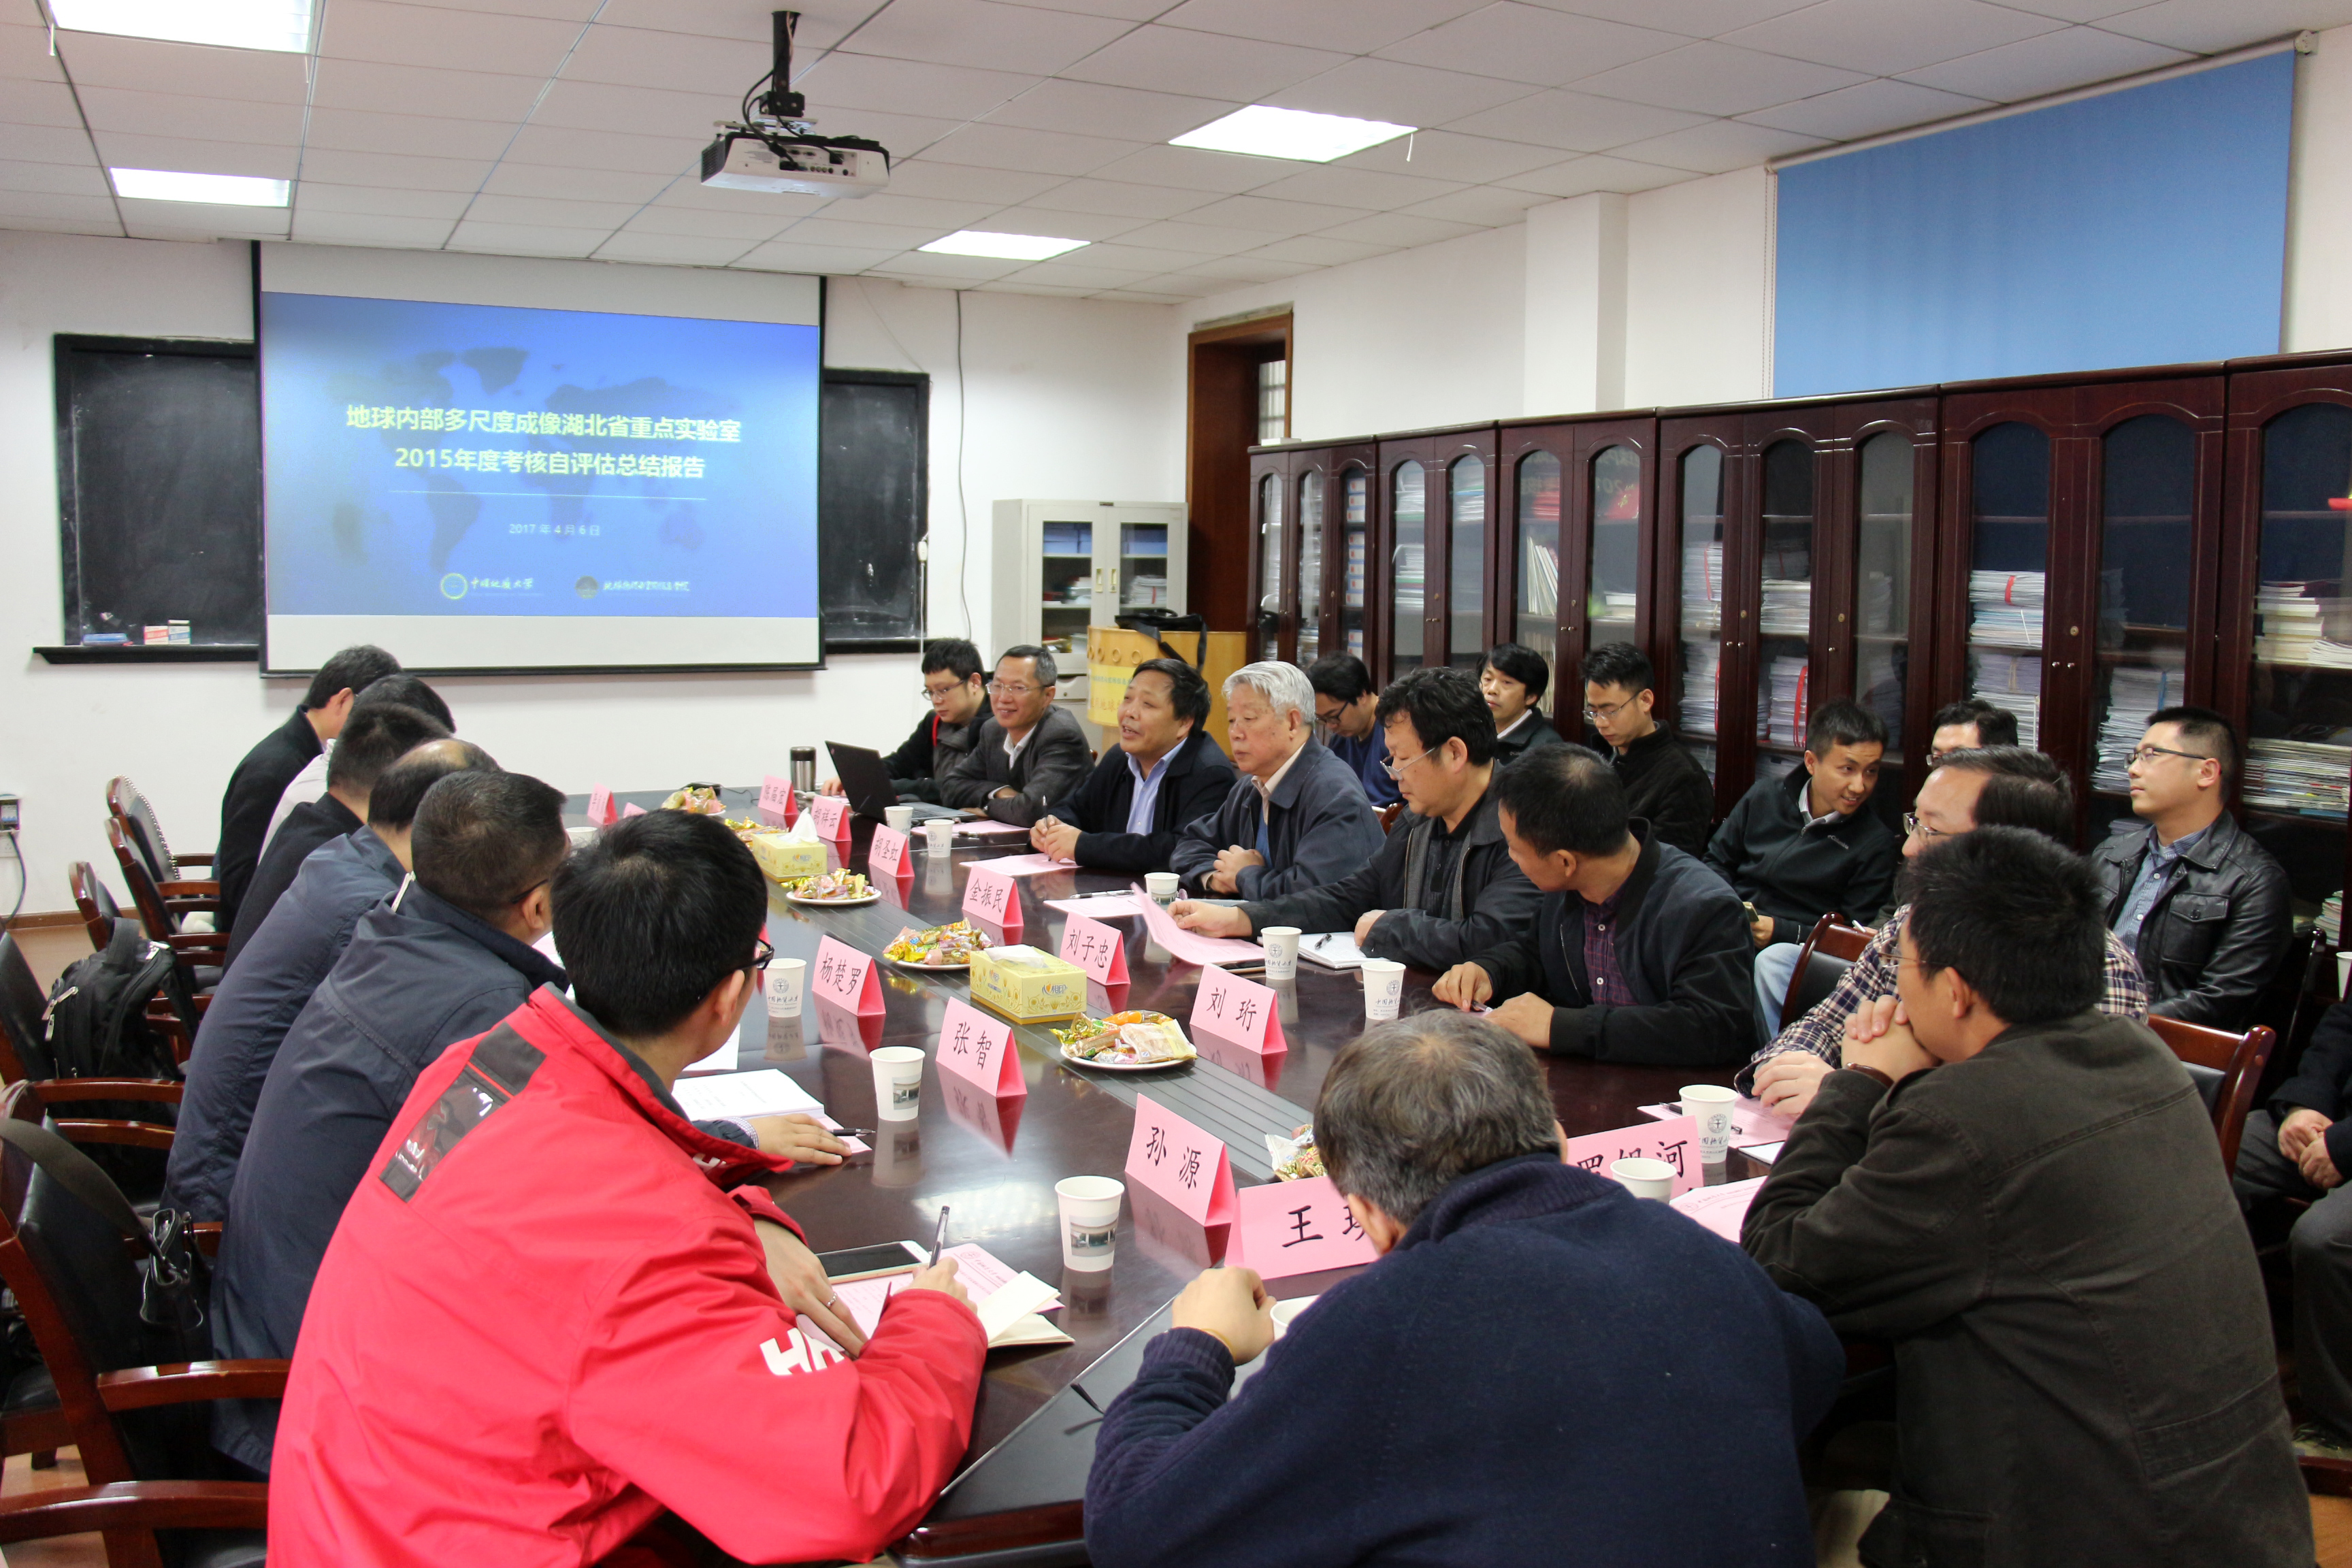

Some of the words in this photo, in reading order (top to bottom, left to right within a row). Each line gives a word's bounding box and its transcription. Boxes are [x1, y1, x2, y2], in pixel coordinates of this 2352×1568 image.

[346, 404, 741, 442] 地球内部多尺度成像湖北省重点实验室
[395, 448, 705, 478] 2015年度考核自评估总结报告
[970, 878, 1003, 913] 金振民
[1066, 929, 1108, 968] 刘子忠
[820, 952, 861, 995] 杨楚罗
[1207, 987, 1256, 1032] 刘珩
[953, 1022, 992, 1070] 张智
[1146, 1126, 1201, 1190] 孙源
